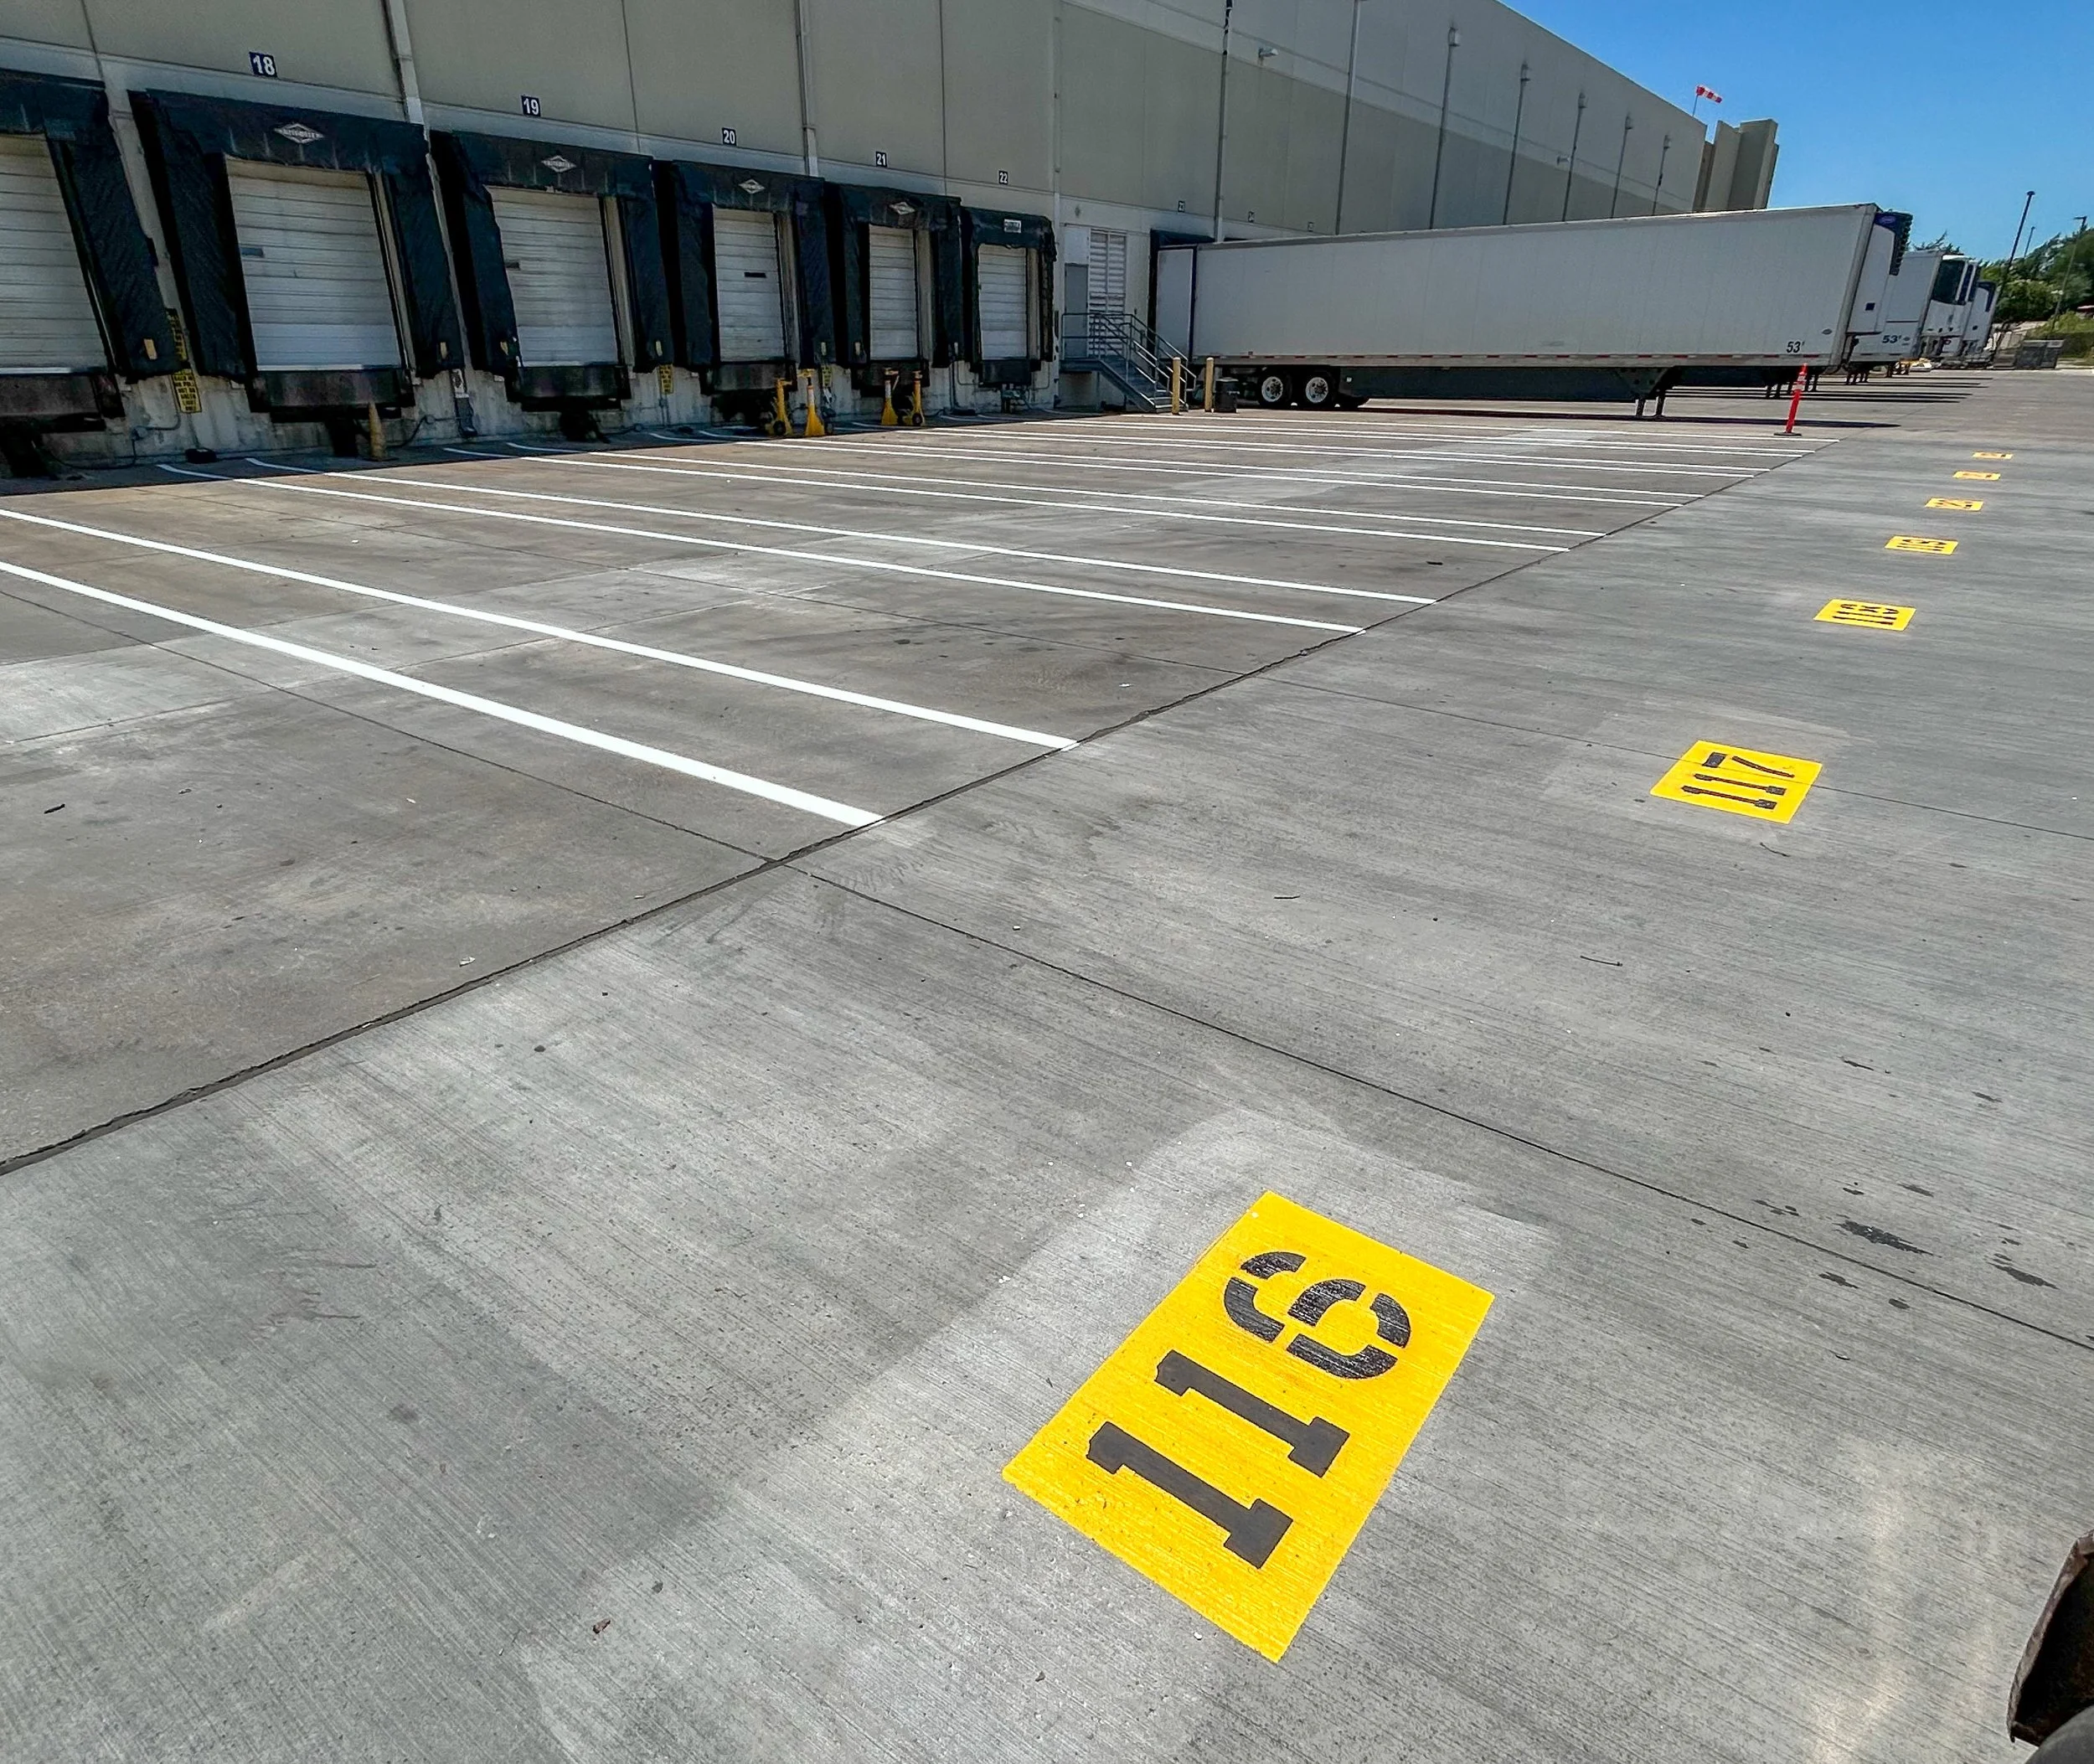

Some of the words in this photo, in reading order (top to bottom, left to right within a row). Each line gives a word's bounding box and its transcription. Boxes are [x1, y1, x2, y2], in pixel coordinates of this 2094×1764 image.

[253, 54, 276, 75] 18
[524, 97, 539, 116] 19
[723, 129, 735, 144] 20
[876, 153, 886, 166] 21
[999, 172, 1008, 183] 22
[1787, 341, 1805, 353] 53'
[1833, 604, 1900, 626] 118
[1680, 752, 1795, 810] 117
[1086, 1251, 1411, 1569] 116
